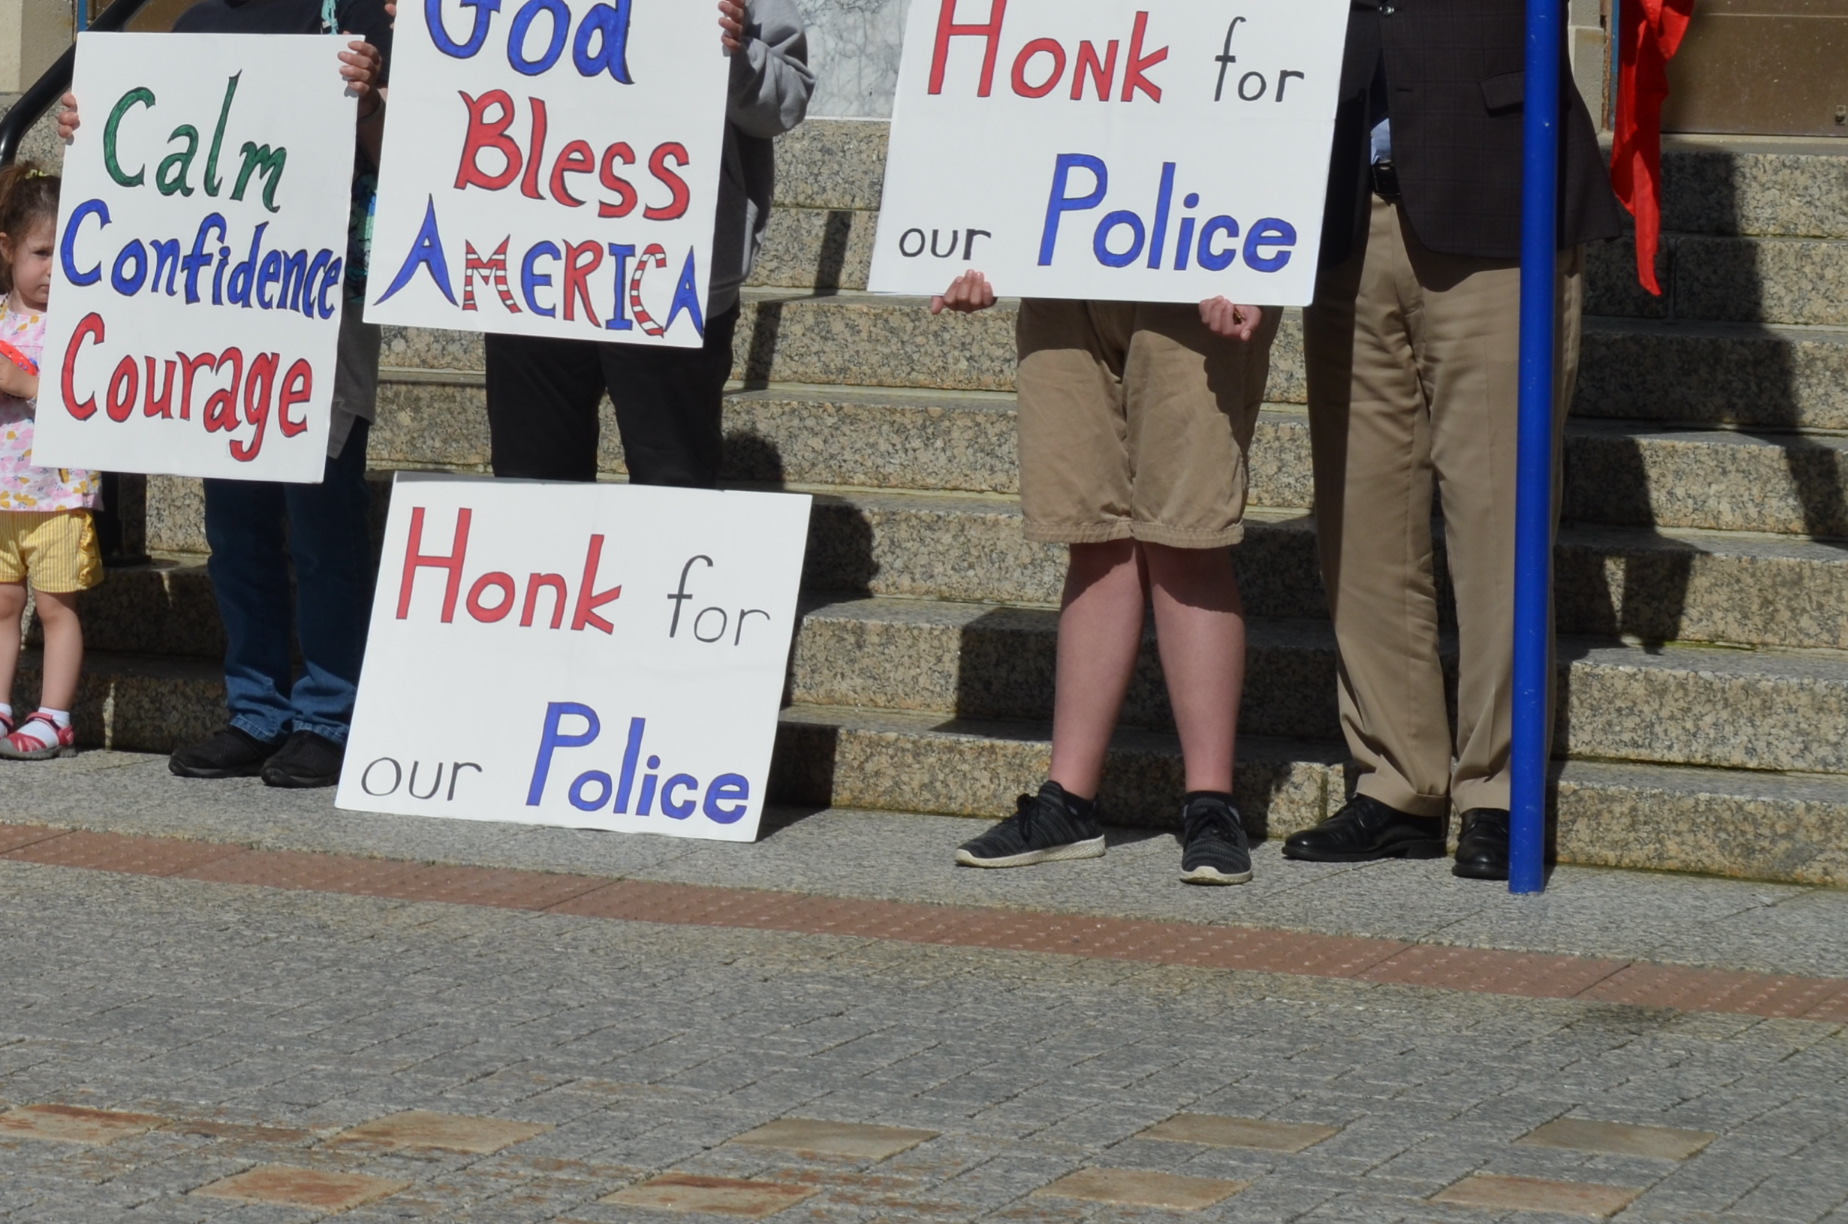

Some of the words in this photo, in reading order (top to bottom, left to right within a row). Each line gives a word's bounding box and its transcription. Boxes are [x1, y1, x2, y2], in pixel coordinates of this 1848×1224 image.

[1213, 16, 1304, 102] for
[103, 69, 287, 213] Calm
[453, 89, 690, 221] Bless
[60, 199, 343, 319] Confidence
[372, 193, 704, 339] AMERICA
[899, 228, 992, 260] our
[1037, 153, 1297, 272] Police
[61, 312, 312, 462] Courage
[395, 507, 622, 635] Honk
[667, 555, 770, 646] for
[361, 757, 483, 801] our
[525, 701, 750, 824] Police
